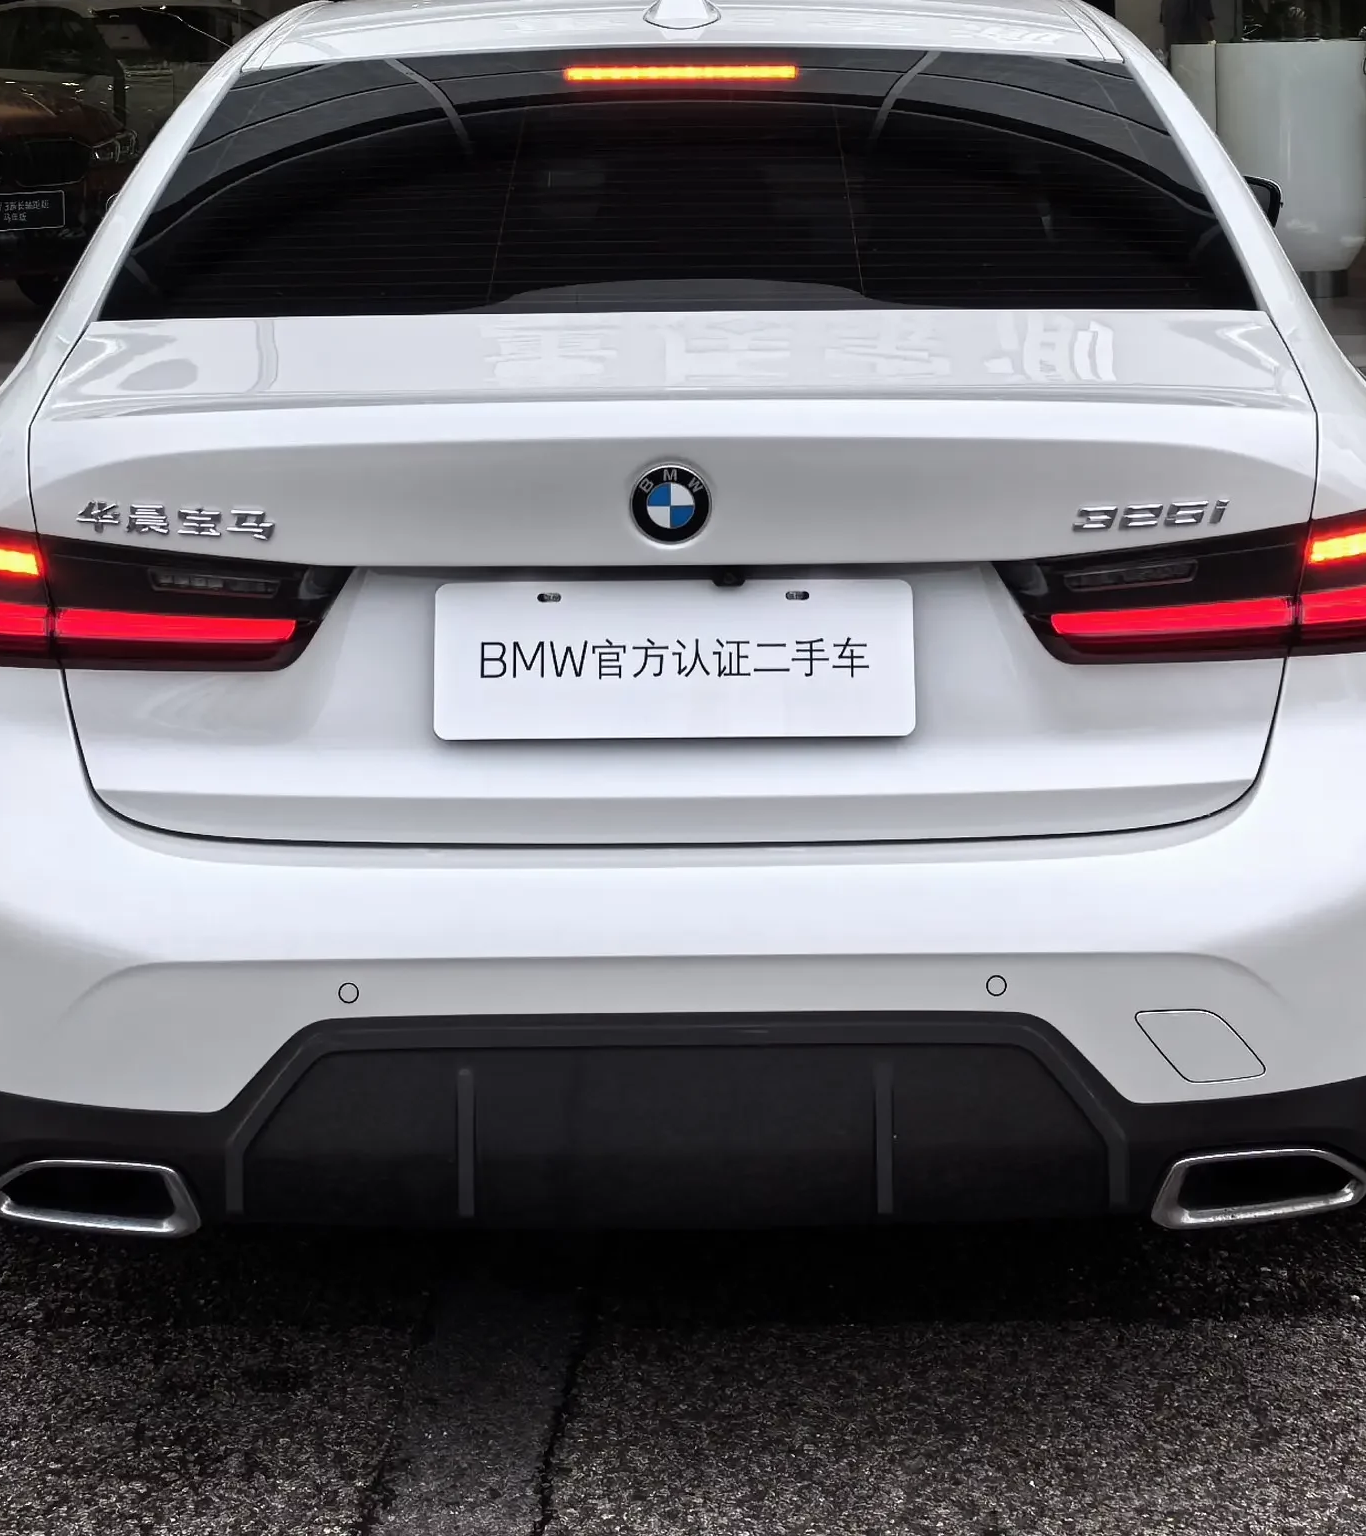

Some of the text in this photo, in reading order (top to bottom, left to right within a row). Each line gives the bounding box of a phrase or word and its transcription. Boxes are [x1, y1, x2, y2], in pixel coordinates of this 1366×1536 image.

[638, 469, 703, 494] BMW
[76, 501, 275, 541] 华晨宝马
[1072, 499, 1230, 532] 325i
[479, 637, 870, 680] BMW官方认证二手车
